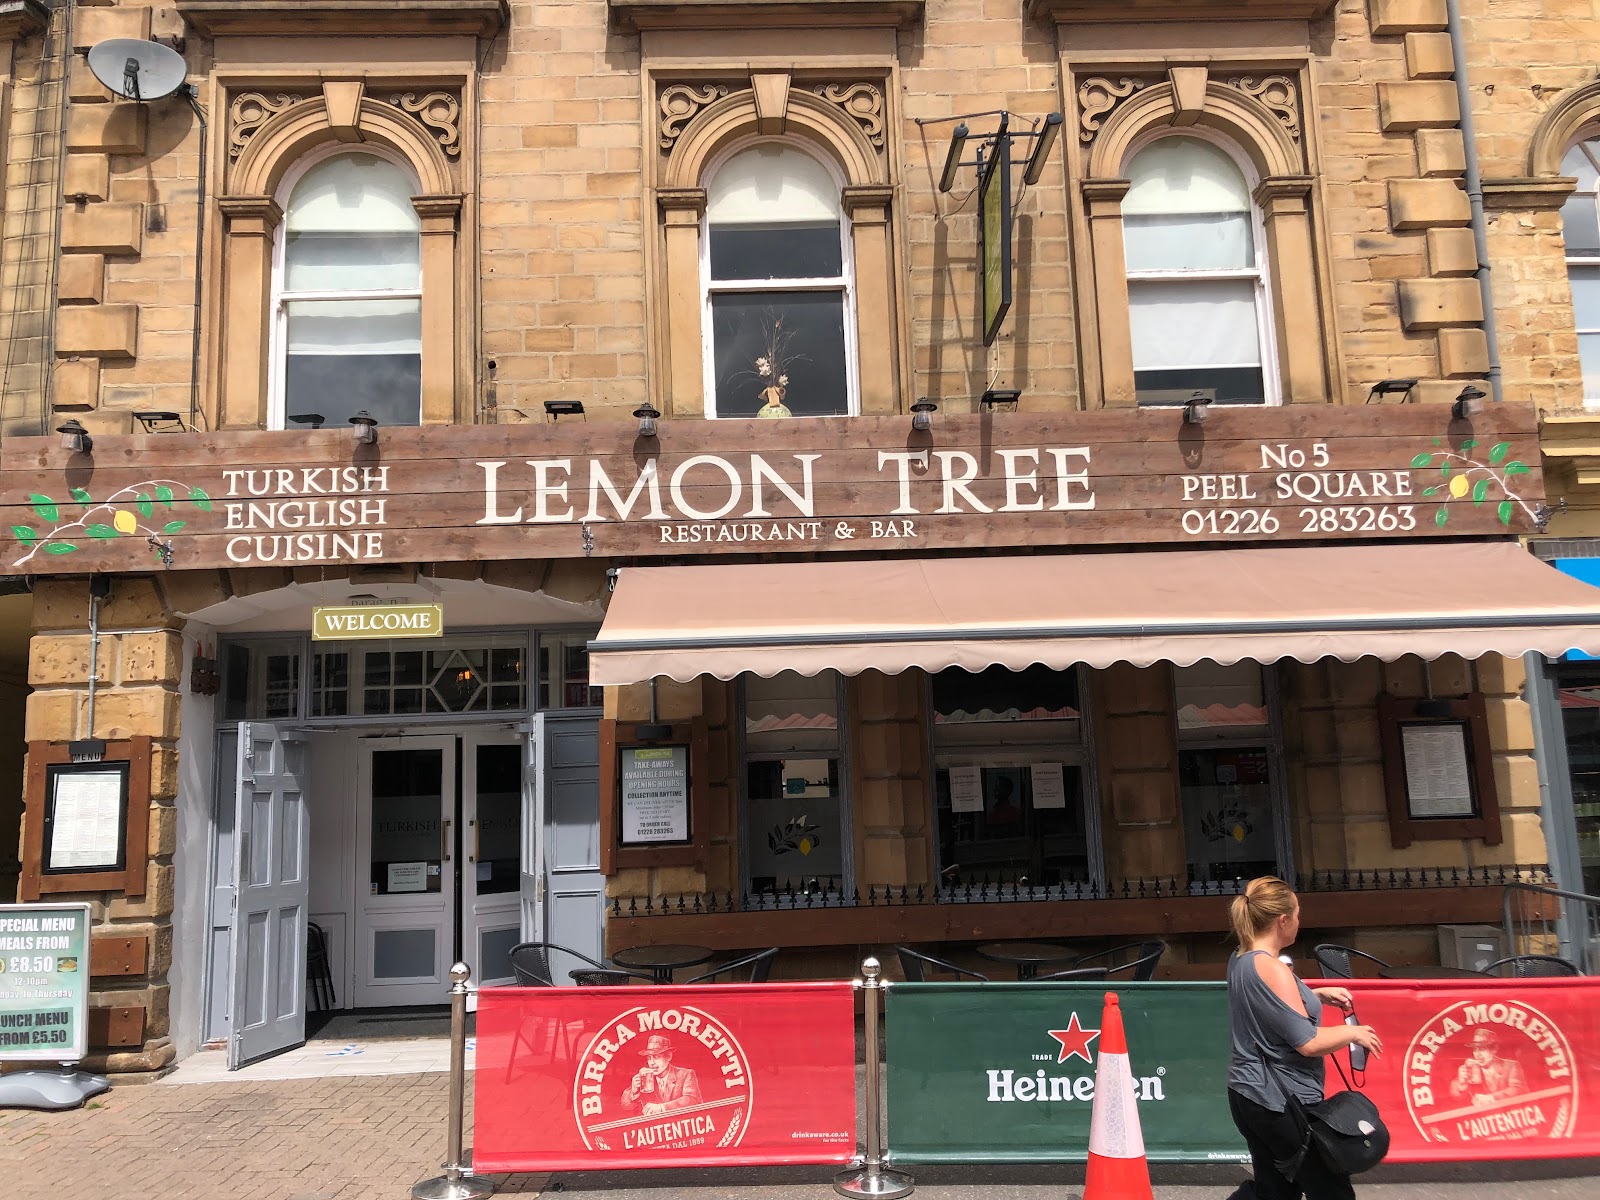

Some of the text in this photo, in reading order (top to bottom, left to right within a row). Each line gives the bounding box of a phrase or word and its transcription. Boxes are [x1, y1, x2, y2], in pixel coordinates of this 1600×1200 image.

[1259, 443, 1330, 469] No 5
[222, 466, 390, 496] TURKISH
[475, 446, 1096, 525] LEMON TREE
[1180, 471, 1413, 503] PEEL SQUARE
[223, 498, 387, 530] ENGLISH
[1181, 505, 1417, 535] 01226 283263
[659, 520, 918, 543] RESTAURANT & BAR
[225, 533, 384, 563] CUISINE
[325, 613, 431, 631] WELCOME
[74, 752, 99, 761] MENU
[634, 761, 674, 769] TAKE-AWAYS
[625, 771, 657, 780] AVAILABLE
[629, 781, 656, 789] OPENING
[0, 918, 75, 932] PECIAL MENU
[36, 936, 69, 949] FROM
[10, 957, 53, 972] £8.50
[14, 978, 48, 986] 12-10pm
[34, 989, 73, 998] Thursday
[0, 1012, 68, 1027] UNCH MENU
[0, 1030, 66, 1045] FROM £5.50
[582, 1010, 745, 1116] BIRRA MORETTI
[1411, 1004, 1570, 1107] BIRRA MORETTI
[986, 1069, 1165, 1101] Heinen
